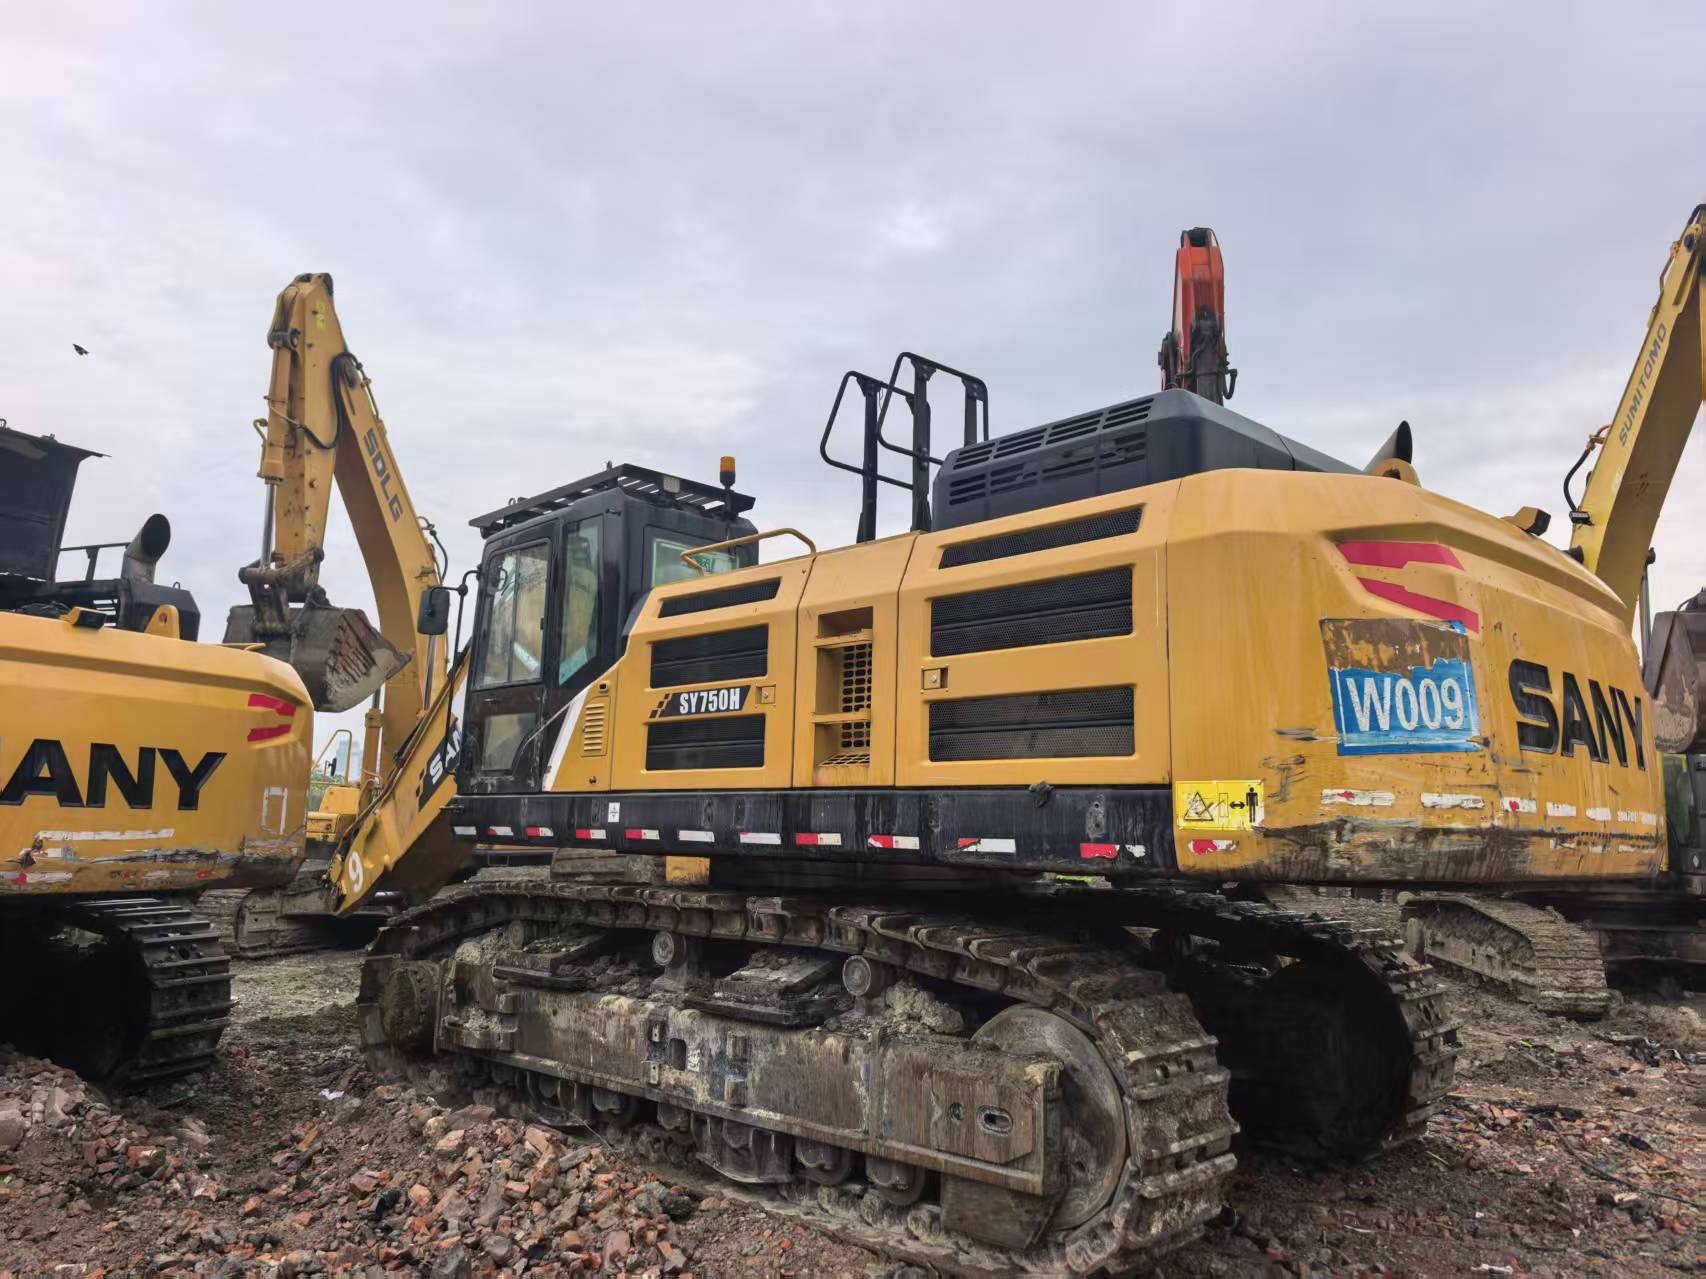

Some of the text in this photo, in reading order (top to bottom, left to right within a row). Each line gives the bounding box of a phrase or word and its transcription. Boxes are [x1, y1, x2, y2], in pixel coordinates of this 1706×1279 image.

[1619, 322, 1666, 447] SUMITOMO
[364, 428, 403, 523] SDLG
[680, 688, 740, 714] SY750H
[1347, 677, 1464, 731] W009
[1508, 659, 1646, 772] SANY
[0, 738, 227, 810] ANY
[430, 730, 461, 784] SAN
